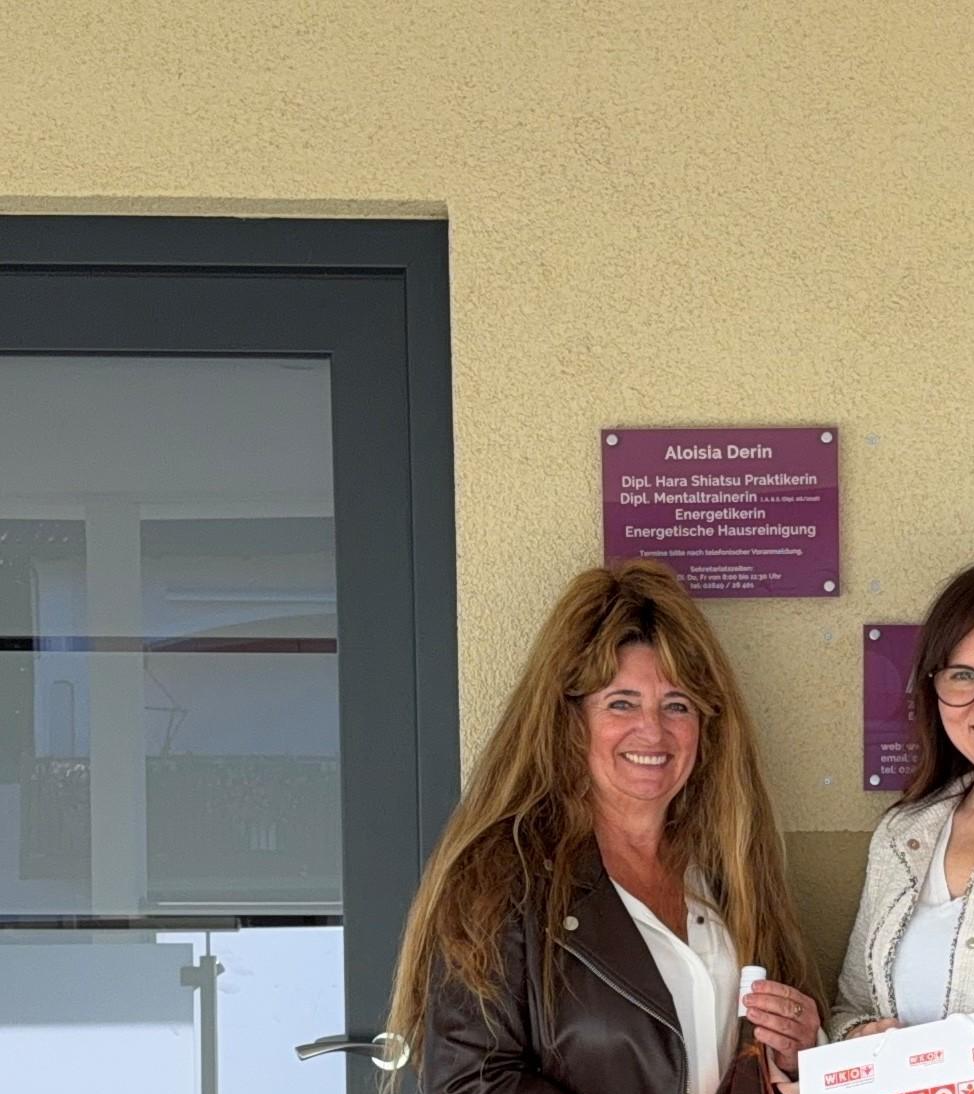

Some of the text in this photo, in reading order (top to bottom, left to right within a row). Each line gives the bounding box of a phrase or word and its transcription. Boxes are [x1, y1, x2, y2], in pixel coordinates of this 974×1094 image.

[664, 443, 773, 460] Aloisia Derin
[621, 473, 817, 490] Dipl. Hara Shiatsu Praktikerin
[620, 492, 651, 507] Dipl.
[654, 490, 758, 504] Mentaltrainerin
[675, 507, 766, 522] Energetikerin
[625, 523, 816, 540] Energetische Hausreinigung
[824, 1067, 861, 1086] WKO
